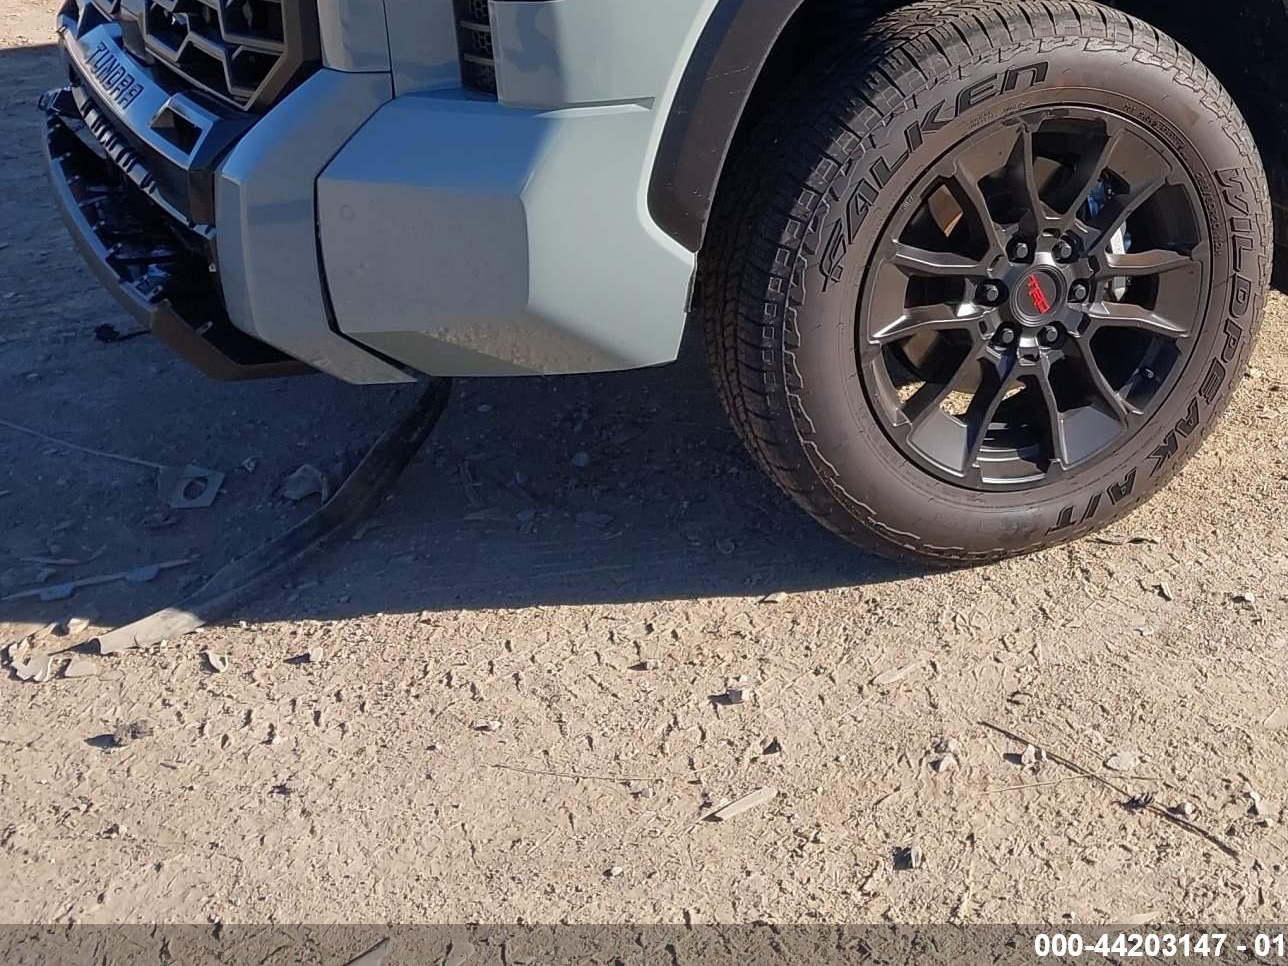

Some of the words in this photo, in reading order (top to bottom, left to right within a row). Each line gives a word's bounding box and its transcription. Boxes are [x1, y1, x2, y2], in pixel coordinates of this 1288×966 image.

[84, 40, 145, 111] TUNDRA
[818, 60, 1050, 293] FALKEN
[1027, 273, 1051, 314] TRD
[1149, 167, 1257, 477] WILDPEAK
[1043, 474, 1138, 534] A/T
